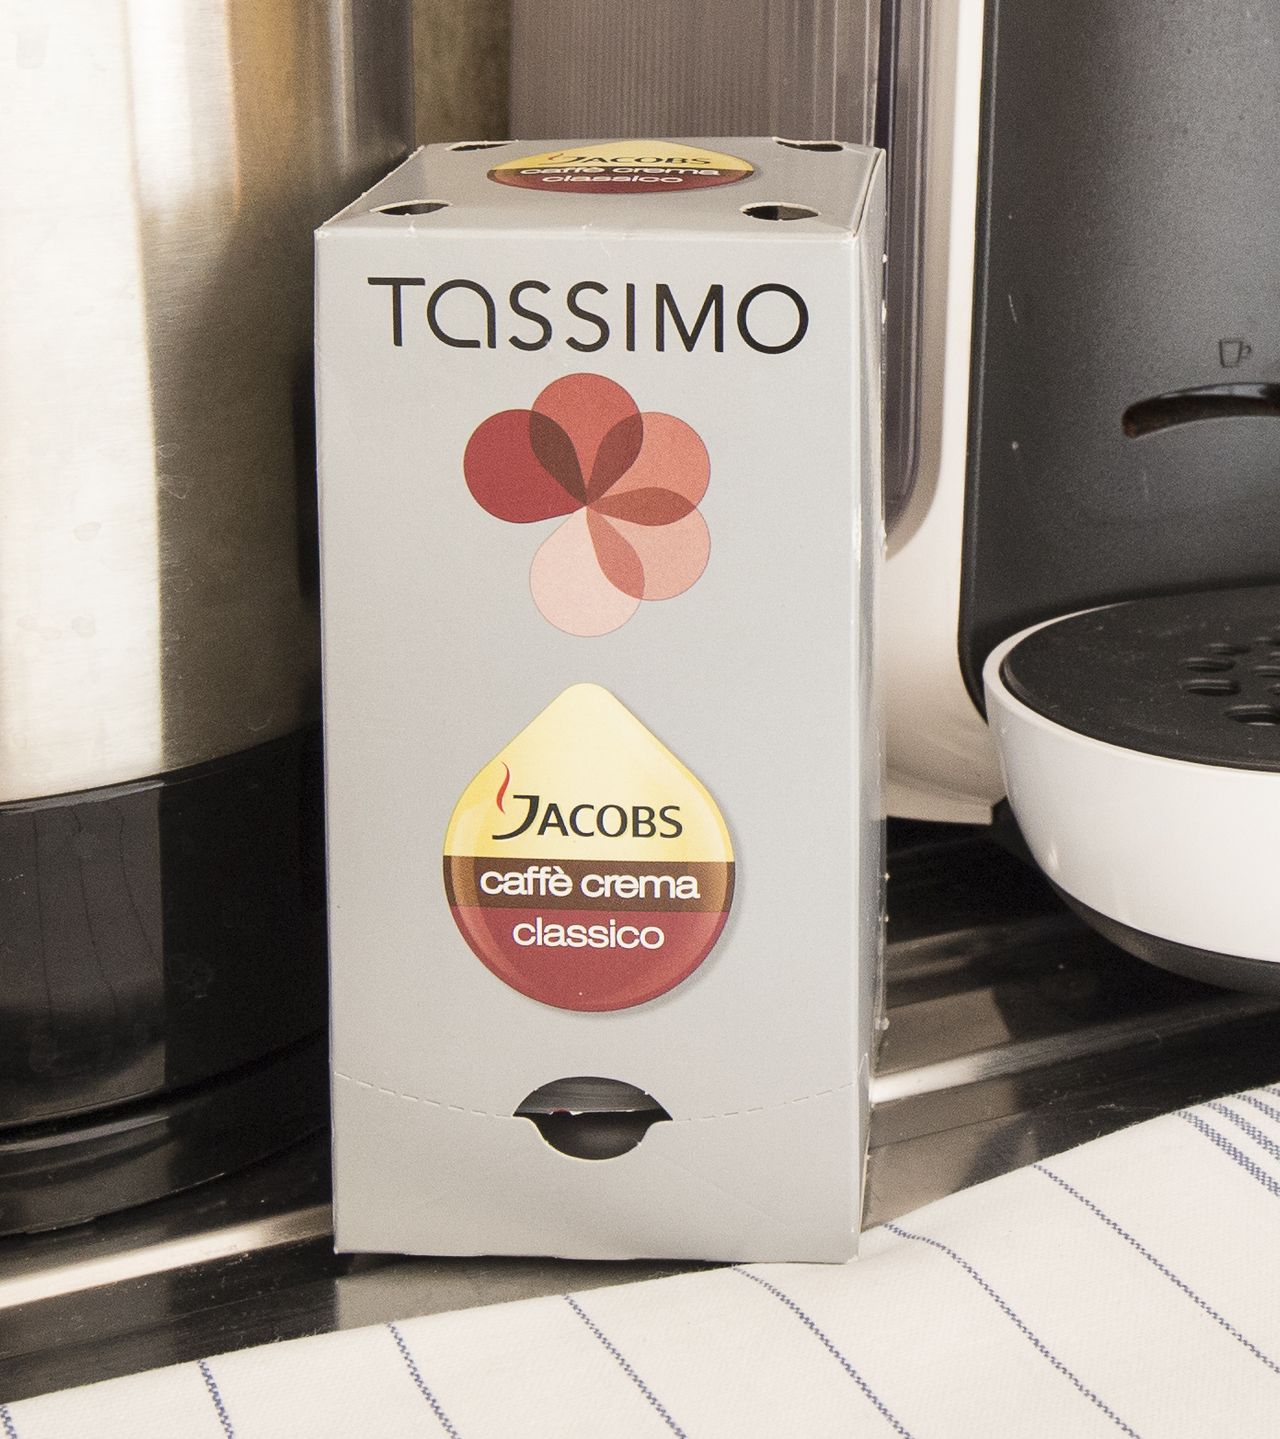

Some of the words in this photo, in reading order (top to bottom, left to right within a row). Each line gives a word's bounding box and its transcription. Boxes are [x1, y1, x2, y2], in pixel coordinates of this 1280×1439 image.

[520, 166, 605, 175] caffè
[612, 167, 720, 176] crema
[540, 156, 711, 165] JACOBS
[542, 175, 683, 183] classico
[367, 277, 809, 354] TASSIMO
[492, 794, 683, 840] JACOBS
[480, 866, 572, 897] caffè
[581, 873, 700, 900] crema
[513, 917, 665, 950] classico
